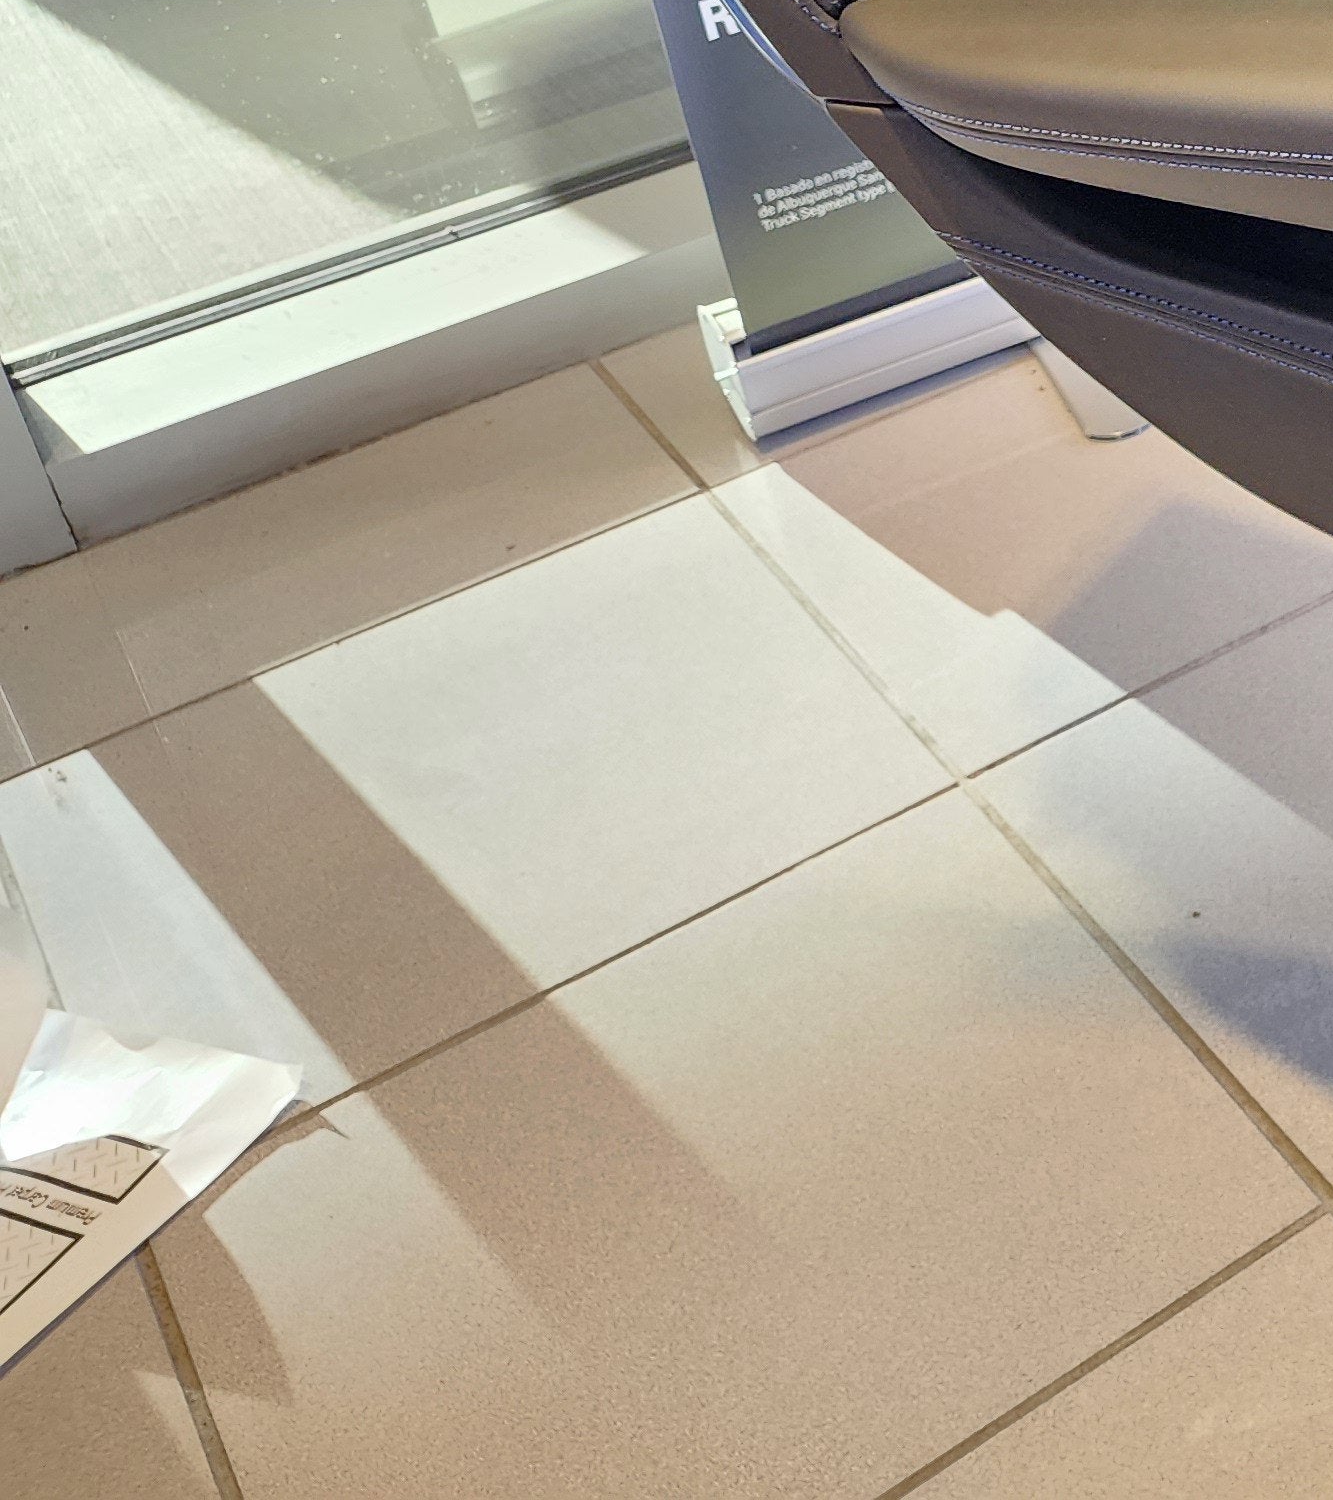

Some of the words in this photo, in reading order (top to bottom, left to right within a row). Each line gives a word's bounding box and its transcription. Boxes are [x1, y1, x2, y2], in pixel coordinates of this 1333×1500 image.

[758, 205, 776, 219] de
[776, 180, 859, 214] Albuquerque
[760, 210, 800, 232] Truck
[799, 193, 858, 221] Segment
